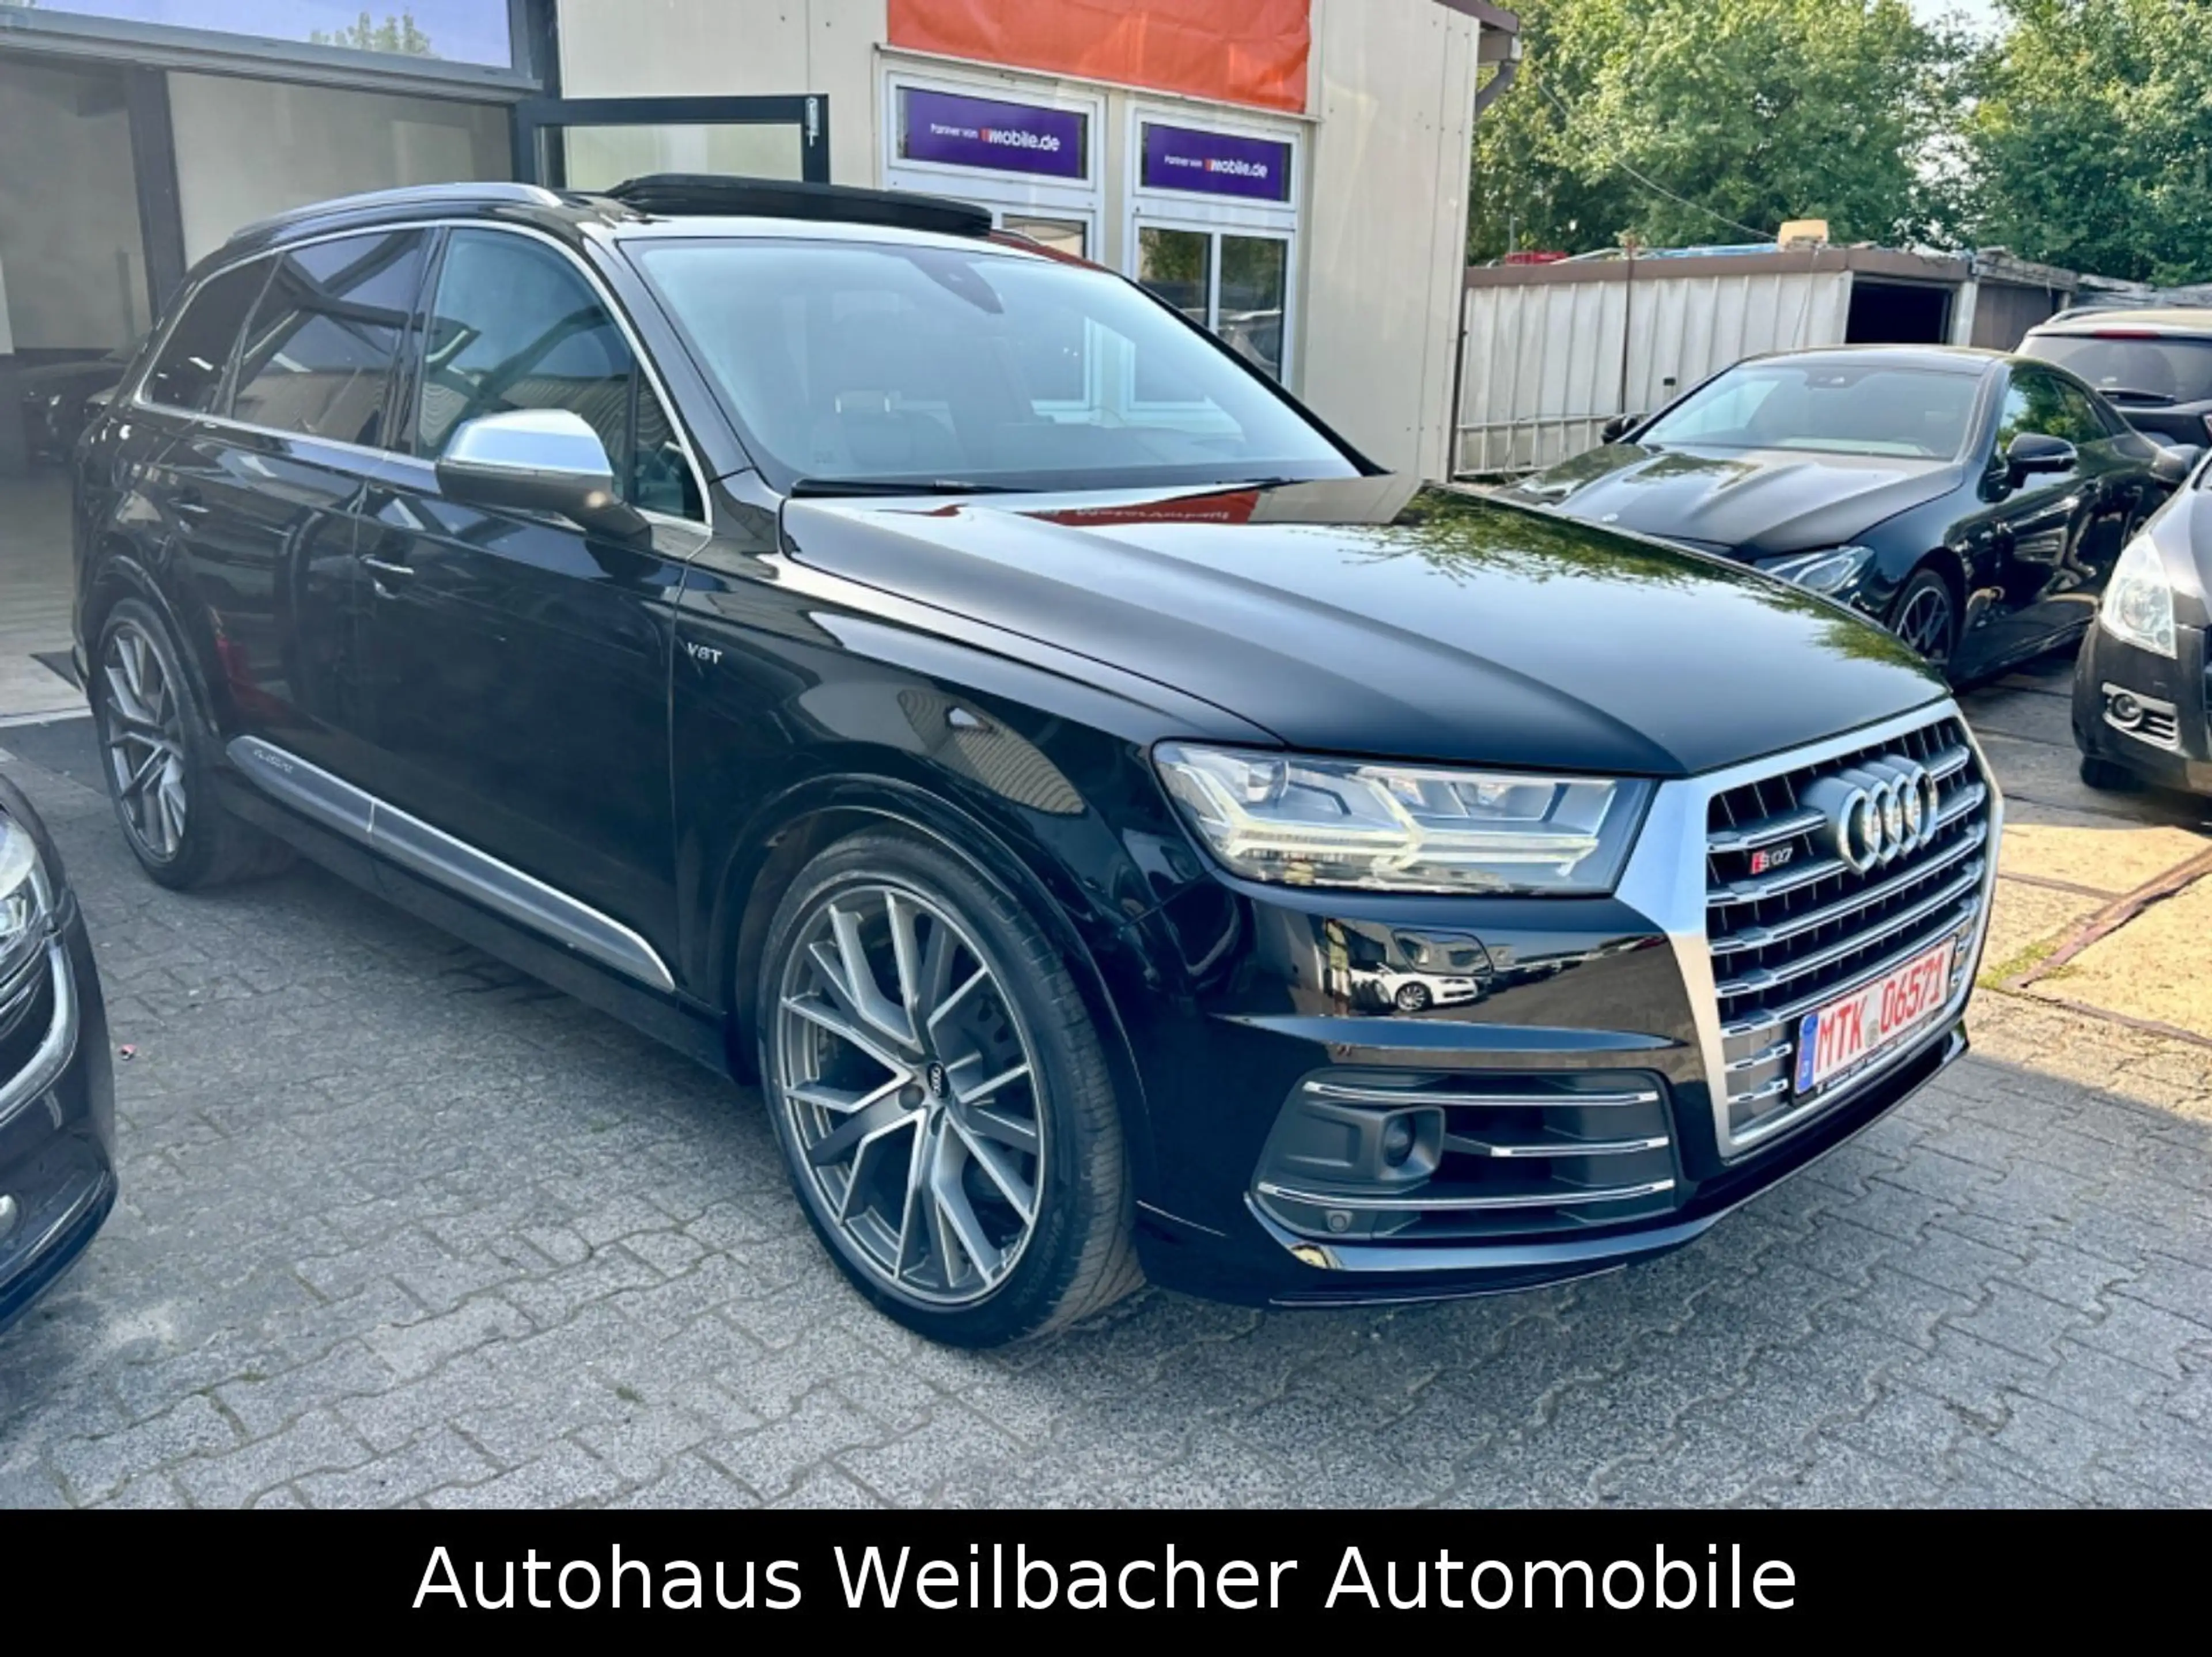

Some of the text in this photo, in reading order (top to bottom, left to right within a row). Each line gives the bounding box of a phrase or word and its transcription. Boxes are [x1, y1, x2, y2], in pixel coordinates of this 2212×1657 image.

[988, 128, 1061, 151] mobile.de
[1210, 160, 1268, 178] mobile.de
[687, 642, 723, 664] V8T
[1815, 952, 1945, 1073] MTK 06571
